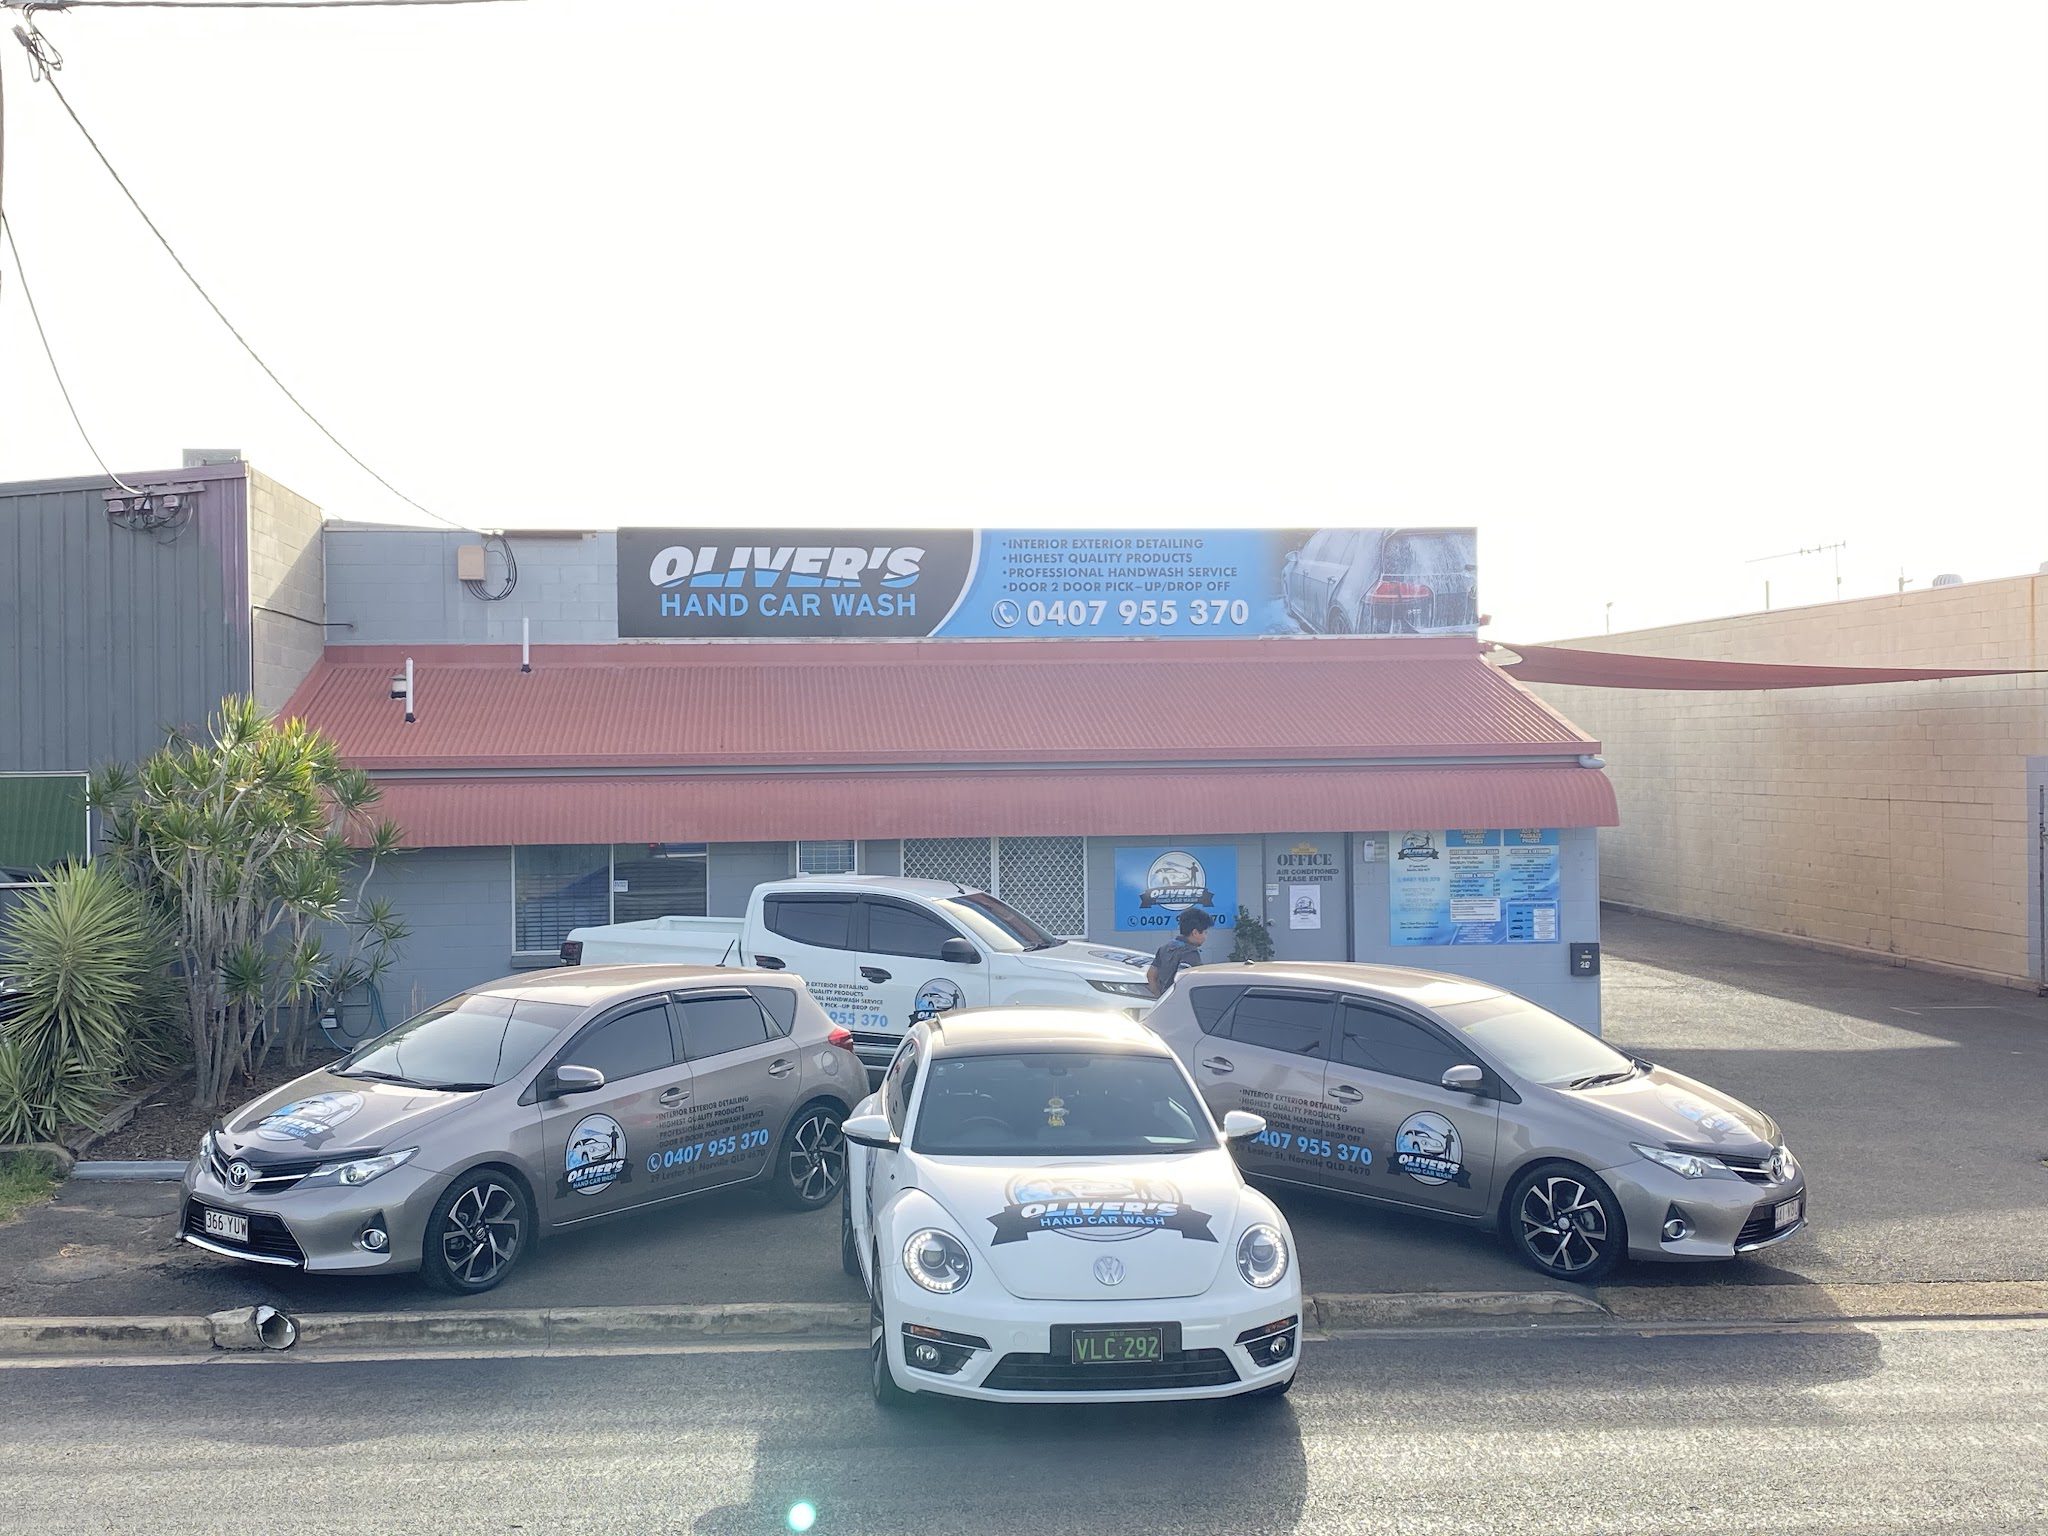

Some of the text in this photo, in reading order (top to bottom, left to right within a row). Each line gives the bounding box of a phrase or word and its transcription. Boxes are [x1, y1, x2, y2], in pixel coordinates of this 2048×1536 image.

[1008, 539, 1204, 549] INTERIOR EXTERIOR DETAILING
[649, 545, 926, 588] OLIVER'S
[1008, 553, 1193, 564] HIGHEST QUALITY PRODUCTS
[1008, 567, 1238, 578] PROFESSIONAL HANDWASH SERVICE
[1009, 582, 1048, 592] DOOR
[1052, 582, 1059, 592] 2
[1063, 582, 1101, 592] DOOR
[1206, 581, 1231, 591] OFF
[661, 593, 916, 617] HAND CAR WASH
[1026, 600, 1249, 627] 0407 955 370
[1277, 853, 1333, 866] OFFICE
[1150, 888, 1205, 899] OLIVER'S
[1140, 915, 1172, 926] 0407
[826, 996, 860, 1004] HANDWASH
[829, 1011, 888, 1028] 955 370
[658, 1096, 750, 1120] INTERIOR EXTERIOR DETAILING
[1242, 1088, 1348, 1112] INTERIOR EXTERIOR DETAILING
[1242, 1098, 1341, 1120] HIGHEST QUALITY PRODUCTS
[660, 1117, 686, 1128] HIGHEST
[714, 1106, 744, 1116] PRODUCTS
[660, 1110, 764, 1138] PROFESSIONAL HANDWASH SERVICE
[1293, 1114, 1335, 1130] HANDWASH
[1337, 1124, 1365, 1134] SERVICE
[1270, 1120, 1290, 1130] DOOR
[1325, 1130, 1346, 1139] DROP
[1347, 1134, 1360, 1142] OFF
[664, 1128, 768, 1168] 0407 955 370
[730, 1153, 746, 1163] QLD
[1251, 1130, 1373, 1166] 407 955 370
[568, 1160, 624, 1182] OLIVER'S
[1326, 1161, 1344, 1172] QLD
[1347, 1165, 1370, 1176] 4670
[1398, 1154, 1460, 1174] OLIVER'S
[1422, 1168, 1434, 1176] CAR
[1021, 1202, 1178, 1218] OLIVER'S
[206, 1212, 246, 1236] 366 YUW
[1040, 1216, 1166, 1226] HAND CAR WASH
[1076, 1336, 1159, 1360] VLC 292
